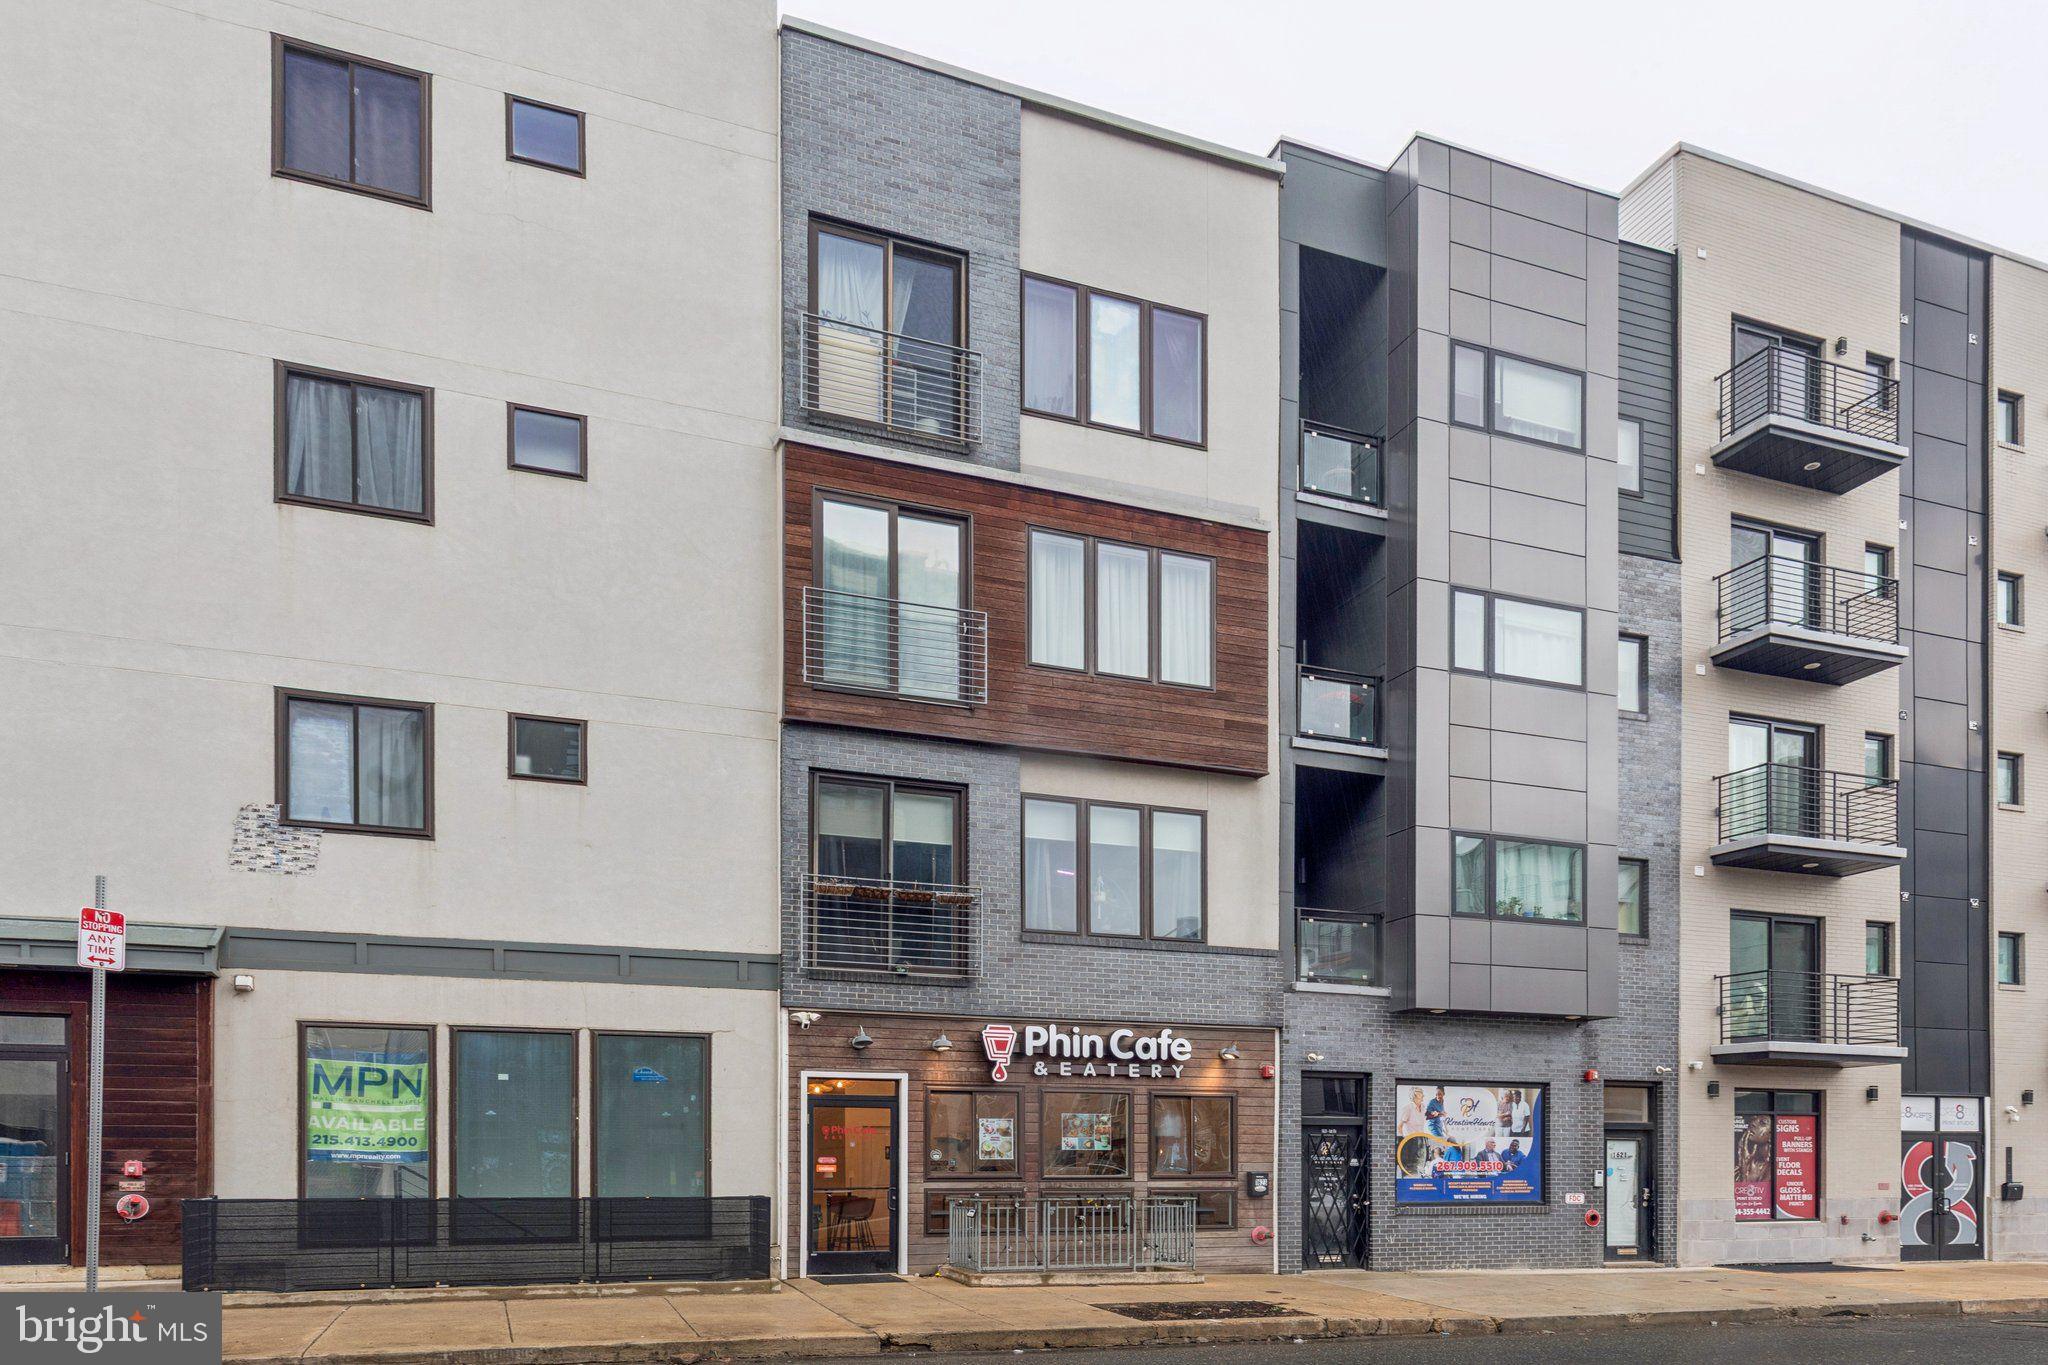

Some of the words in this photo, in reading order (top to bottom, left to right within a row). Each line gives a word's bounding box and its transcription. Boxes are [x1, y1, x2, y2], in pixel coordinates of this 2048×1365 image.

[94, 910, 111, 923] NO
[82, 920, 123, 934] STOPPING
[88, 934, 116, 944] ANY
[87, 944, 116, 956] TIME
[1025, 1024, 1104, 1058] Phin
[1109, 1028, 1193, 1061] Cafe
[1033, 1061, 1049, 1076] &
[1059, 1062, 1185, 1079] EATERY
[312, 1063, 423, 1099] MPN
[308, 1115, 425, 1131] AVAILABLE
[1776, 1124, 1800, 1133] SIGNS
[311, 1134, 418, 1147] 215.413.4900
[1437, 1160, 1504, 1171] 267.909.5510
[1568, 1194, 1582, 1202] FDC
